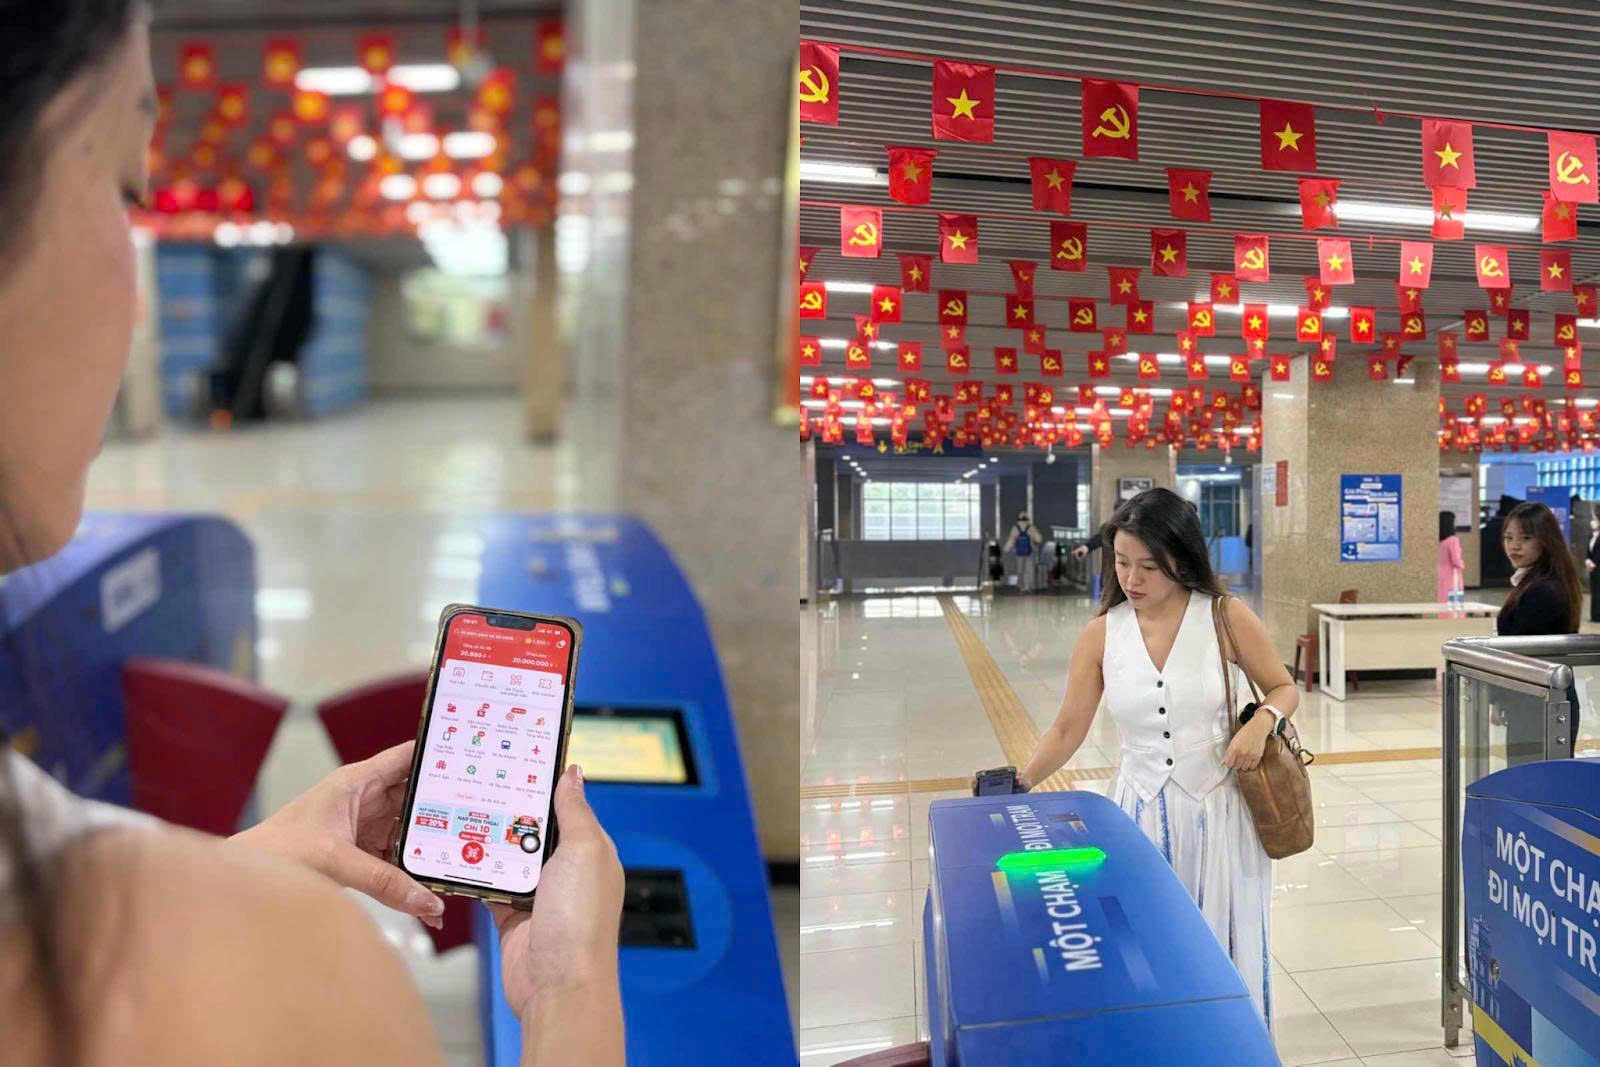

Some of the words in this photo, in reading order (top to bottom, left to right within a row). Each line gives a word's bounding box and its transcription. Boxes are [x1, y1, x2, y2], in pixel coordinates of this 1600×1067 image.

[1496, 826, 1545, 883] MỘT
[1035, 870, 1082, 918] CHẠM
[1049, 922, 1103, 972] MỘT
[1488, 868, 1508, 912] ĐI
[1513, 885, 1557, 945] MỌI
[1561, 917, 1600, 977] TR
